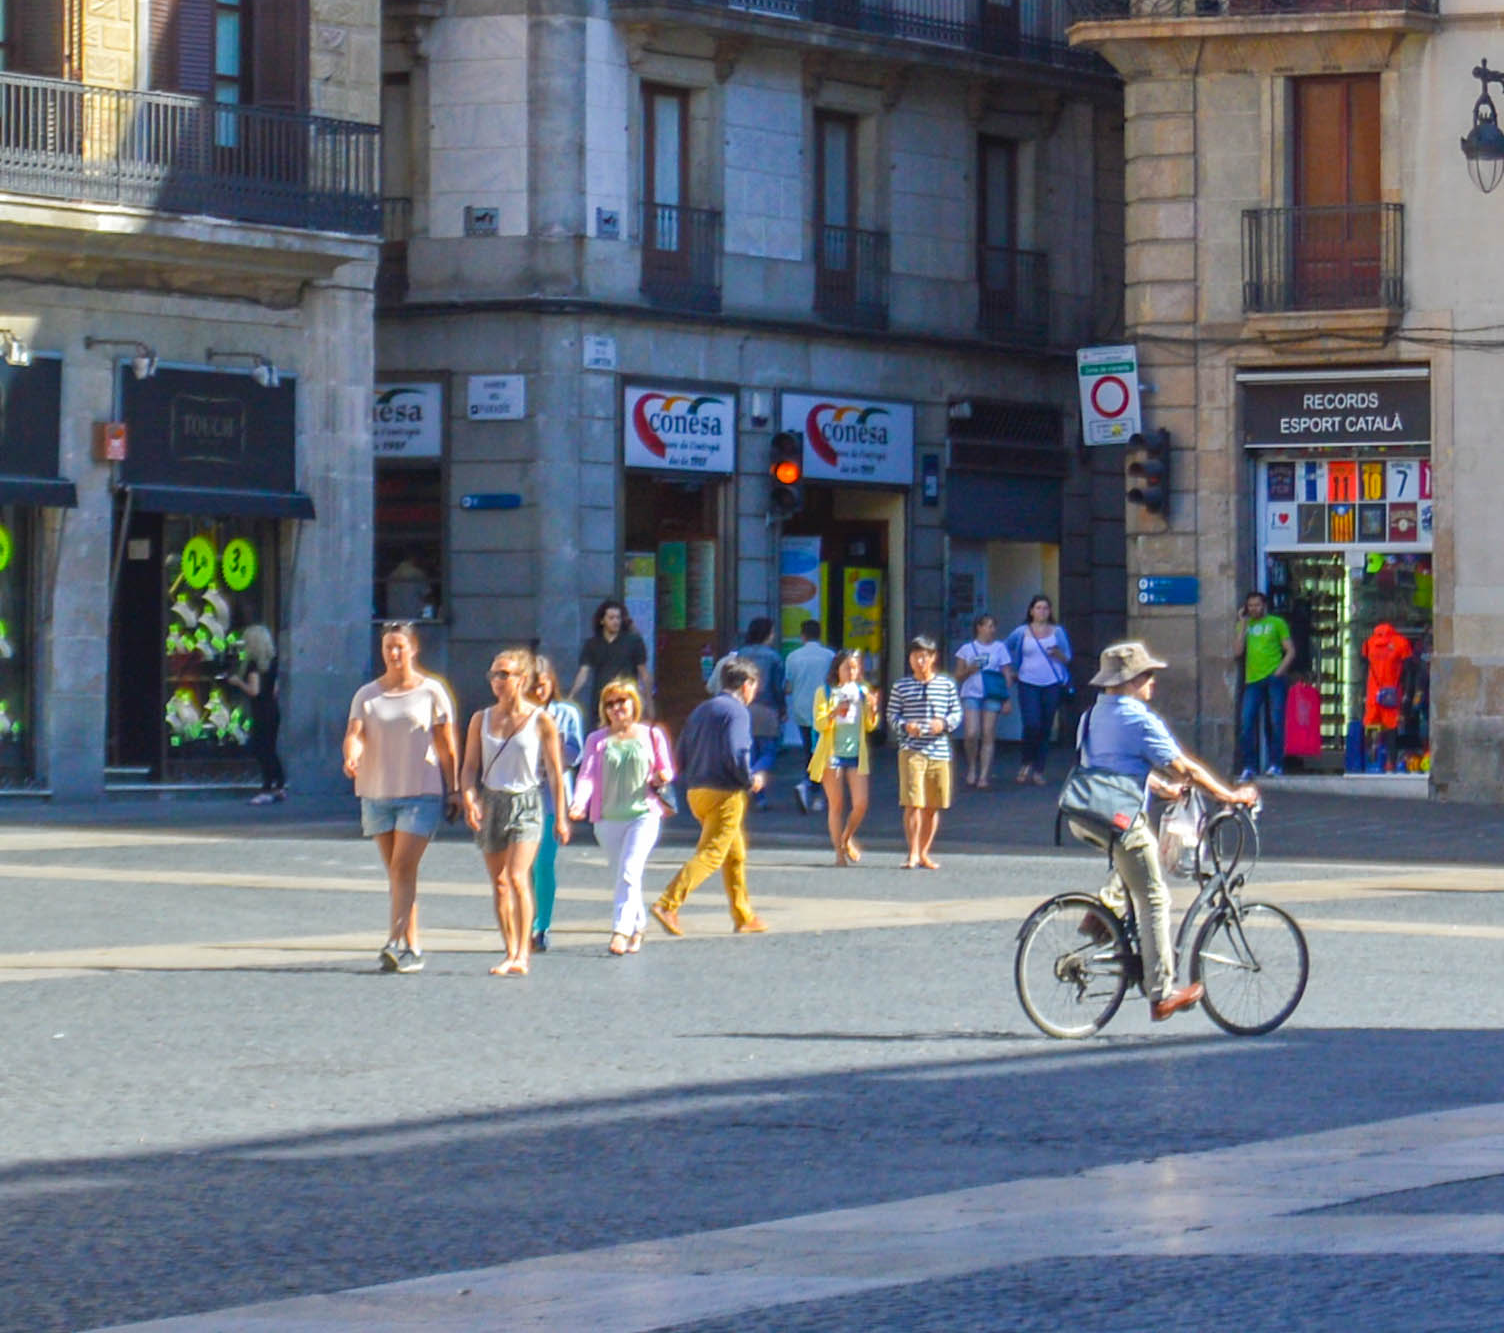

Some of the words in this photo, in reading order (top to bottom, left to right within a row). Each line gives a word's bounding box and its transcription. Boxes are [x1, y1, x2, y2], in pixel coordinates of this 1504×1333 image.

[1303, 392, 1379, 410] RECORDS
[650, 412, 722, 436] conesa
[822, 422, 889, 445] conesa
[1280, 416, 1342, 434] ESPORT
[1345, 412, 1404, 432] CATALÀ
[1362, 472, 1382, 501] 10
[1396, 469, 1408, 498] 7
